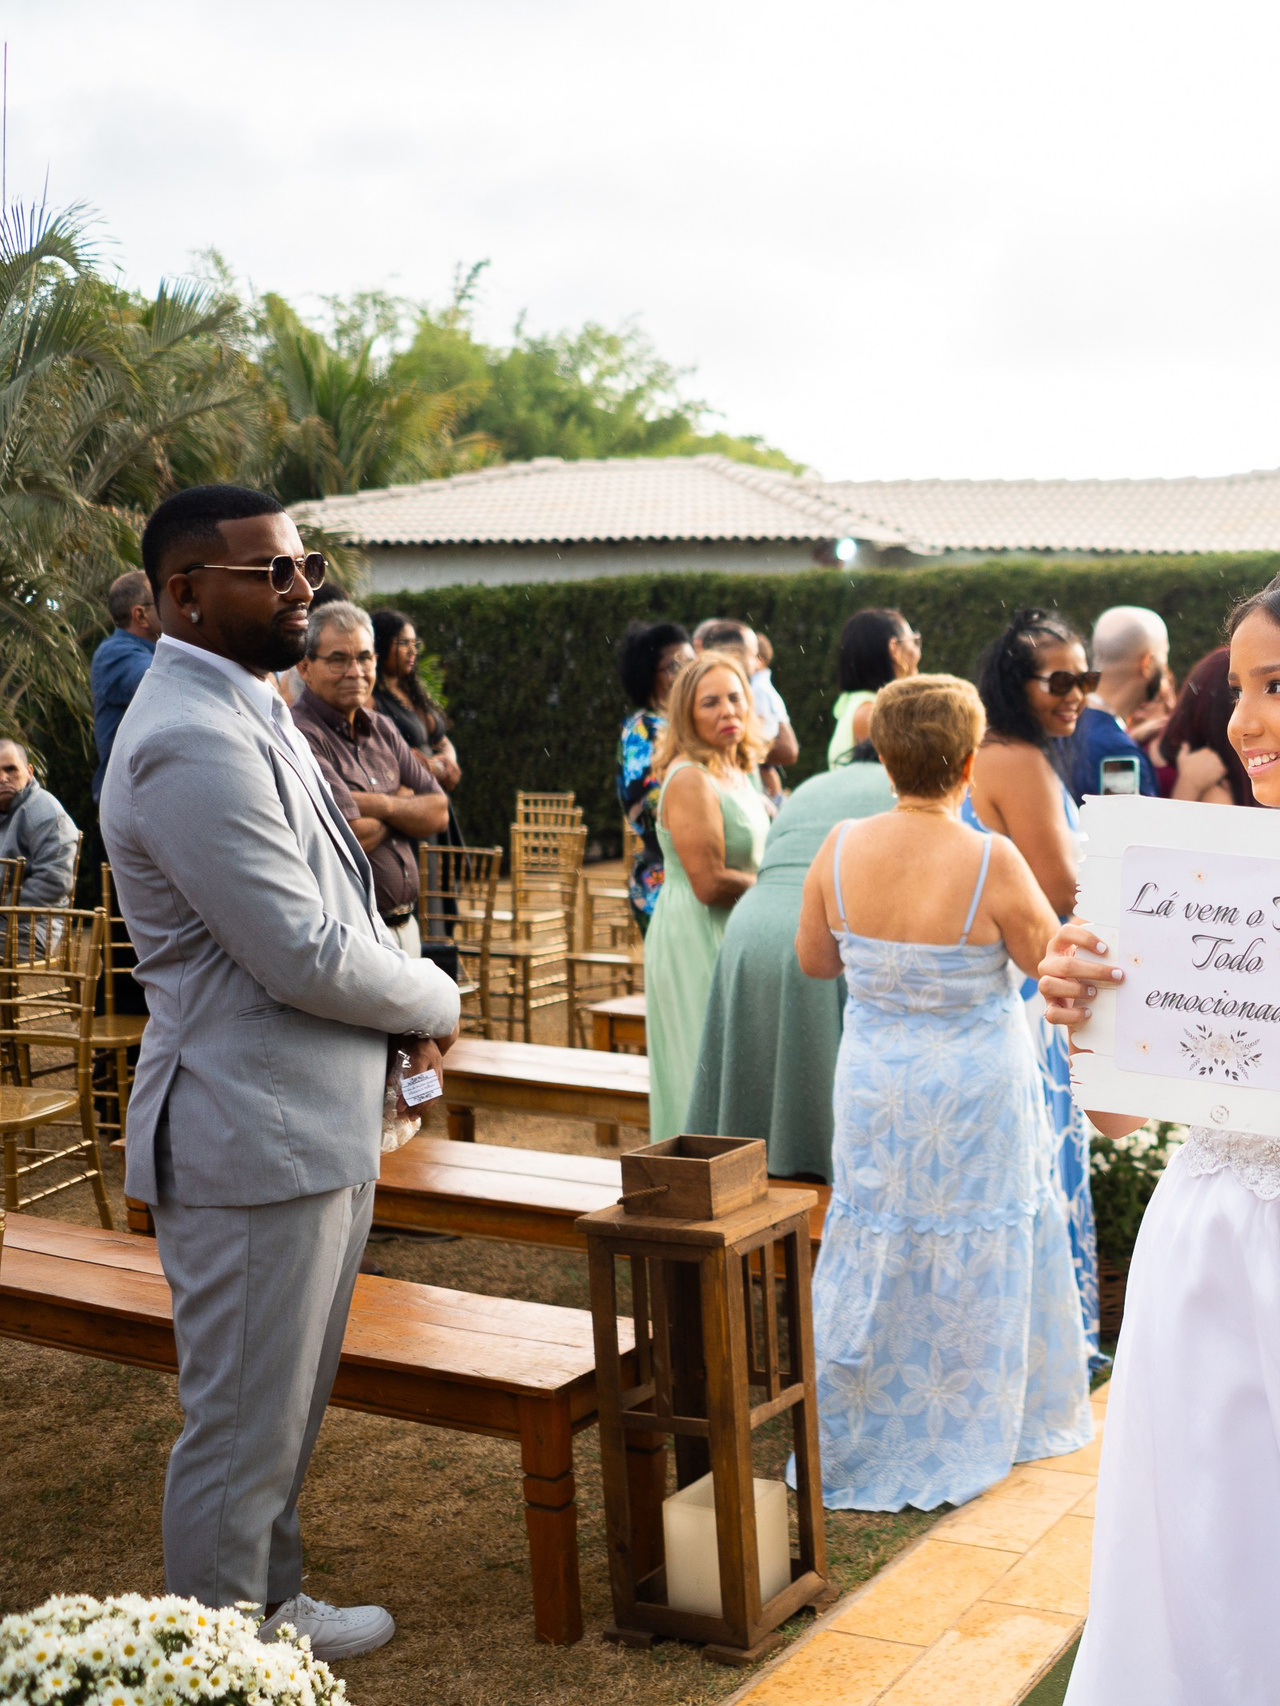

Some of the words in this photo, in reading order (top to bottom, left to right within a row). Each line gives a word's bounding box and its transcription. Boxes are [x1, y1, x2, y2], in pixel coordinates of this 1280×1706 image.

[1127, 882, 1179, 917] Lá
[1183, 902, 1240, 924] vem
[1246, 908, 1265, 926] o
[1191, 934, 1266, 974] Todo
